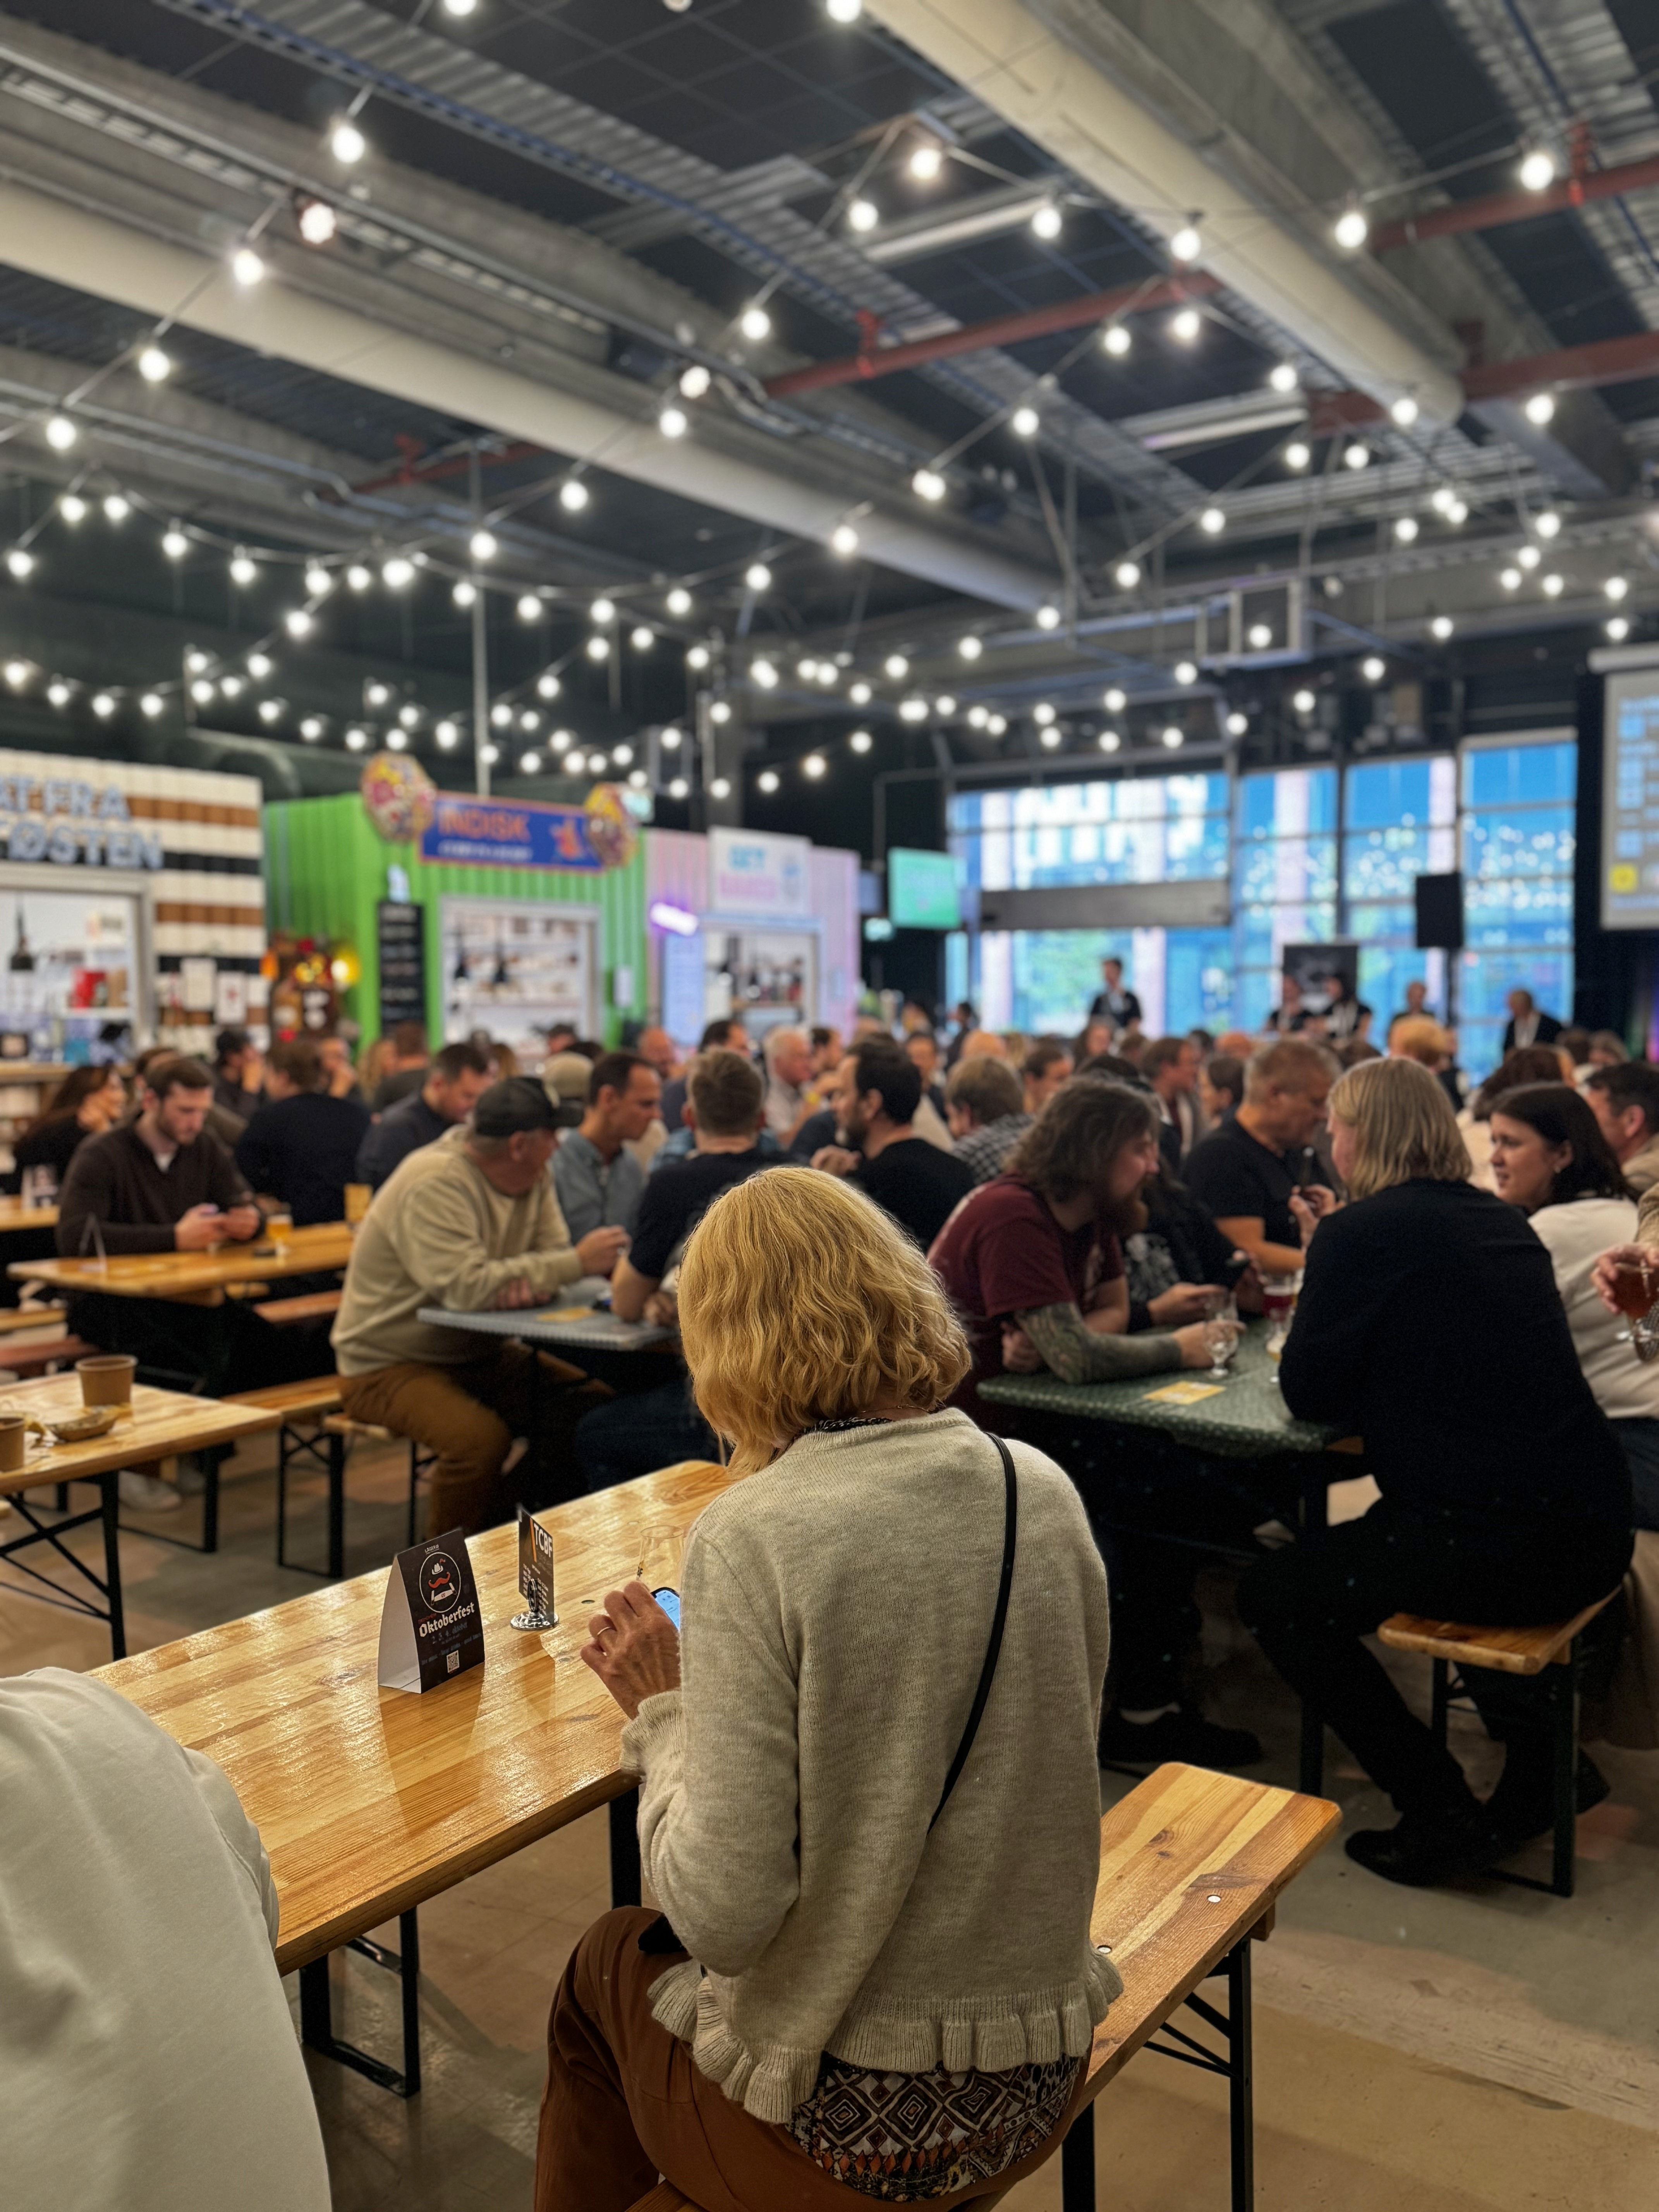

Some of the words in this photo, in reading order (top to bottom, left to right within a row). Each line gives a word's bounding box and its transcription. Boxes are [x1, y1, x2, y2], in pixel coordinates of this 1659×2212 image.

[45, 777, 131, 821] FRA
[440, 807, 530, 842] INDISK
[0, 819, 163, 870] ØSTEN
[534, 1523, 553, 1558] TCBF
[419, 1602, 475, 1637] Oktoberfest
